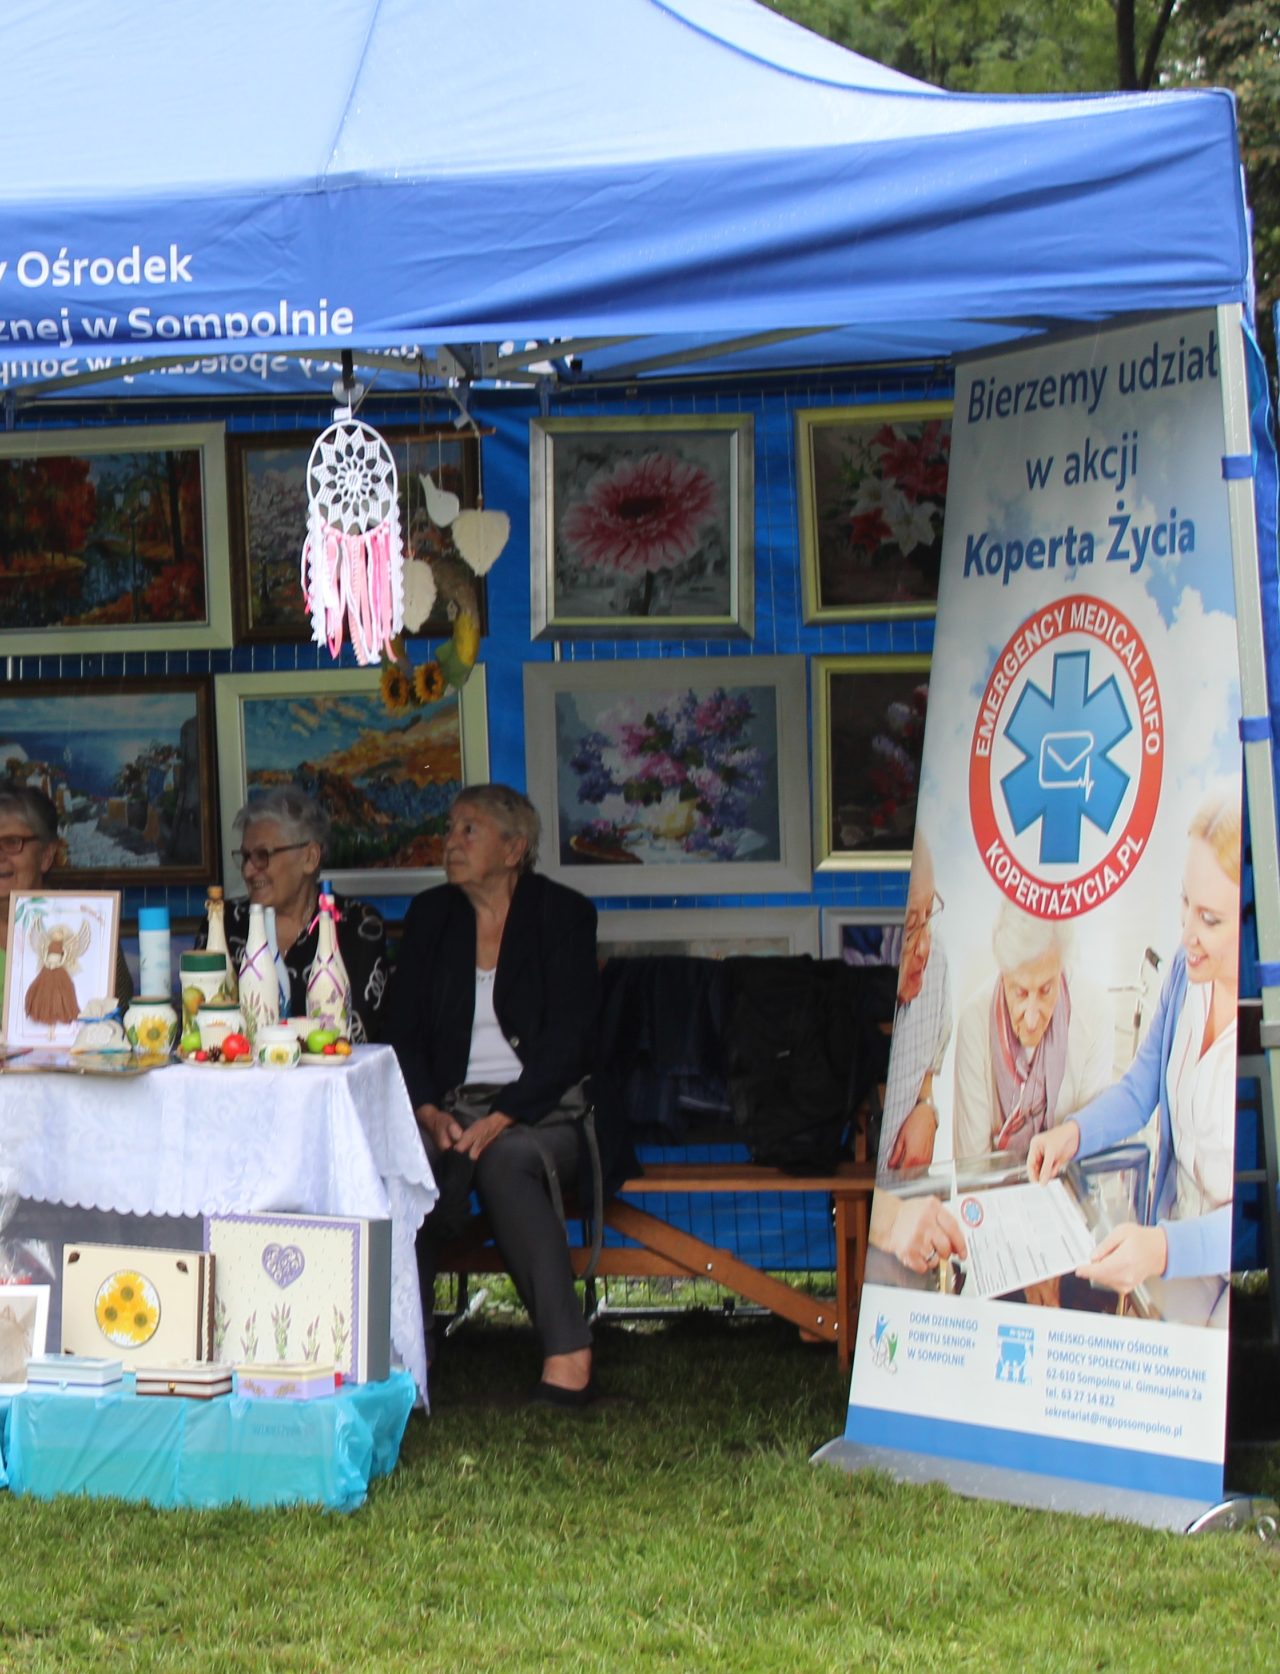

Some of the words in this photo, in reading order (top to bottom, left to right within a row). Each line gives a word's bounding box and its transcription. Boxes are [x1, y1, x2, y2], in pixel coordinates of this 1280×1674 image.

[16, 243, 193, 288] Ośrodek
[80, 315, 118, 339] w
[127, 298, 354, 339] Sompolnie
[967, 364, 1108, 424] Bierzemy
[1119, 330, 1219, 395] udział
[1025, 455, 1054, 491] w
[1063, 430, 1138, 492] akcji
[963, 526, 1095, 586] Koperta
[1105, 499, 1196, 574] Życia
[975, 605, 1065, 758] EMERGENCY
[1070, 602, 1144, 680] MEDICAL
[1137, 676, 1161, 756] INFO
[986, 834, 1144, 916] KOPERTAŻYCIA.PL
[908, 1330, 940, 1345] POBYTU
[909, 1311, 931, 1325] DOM
[931, 1314, 979, 1332] DZIENNEGO
[907, 1348, 916, 1359] W
[918, 1349, 965, 1366] SOMPOLNIE
[1047, 1349, 1086, 1364] POMOCY
[1087, 1354, 1141, 1372] SPOŁECZNEJ
[1142, 1363, 1152, 1375] W
[1154, 1365, 1207, 1382] SOMPOLNIE
[1127, 1338, 1169, 1357] OŚRODEK
[1077, 1371, 1120, 1388] Sompolno
[1122, 1379, 1133, 1391] ul.
[1136, 1382, 1190, 1399] Gimnazjalna
[1191, 1389, 1202, 1401] 2a
